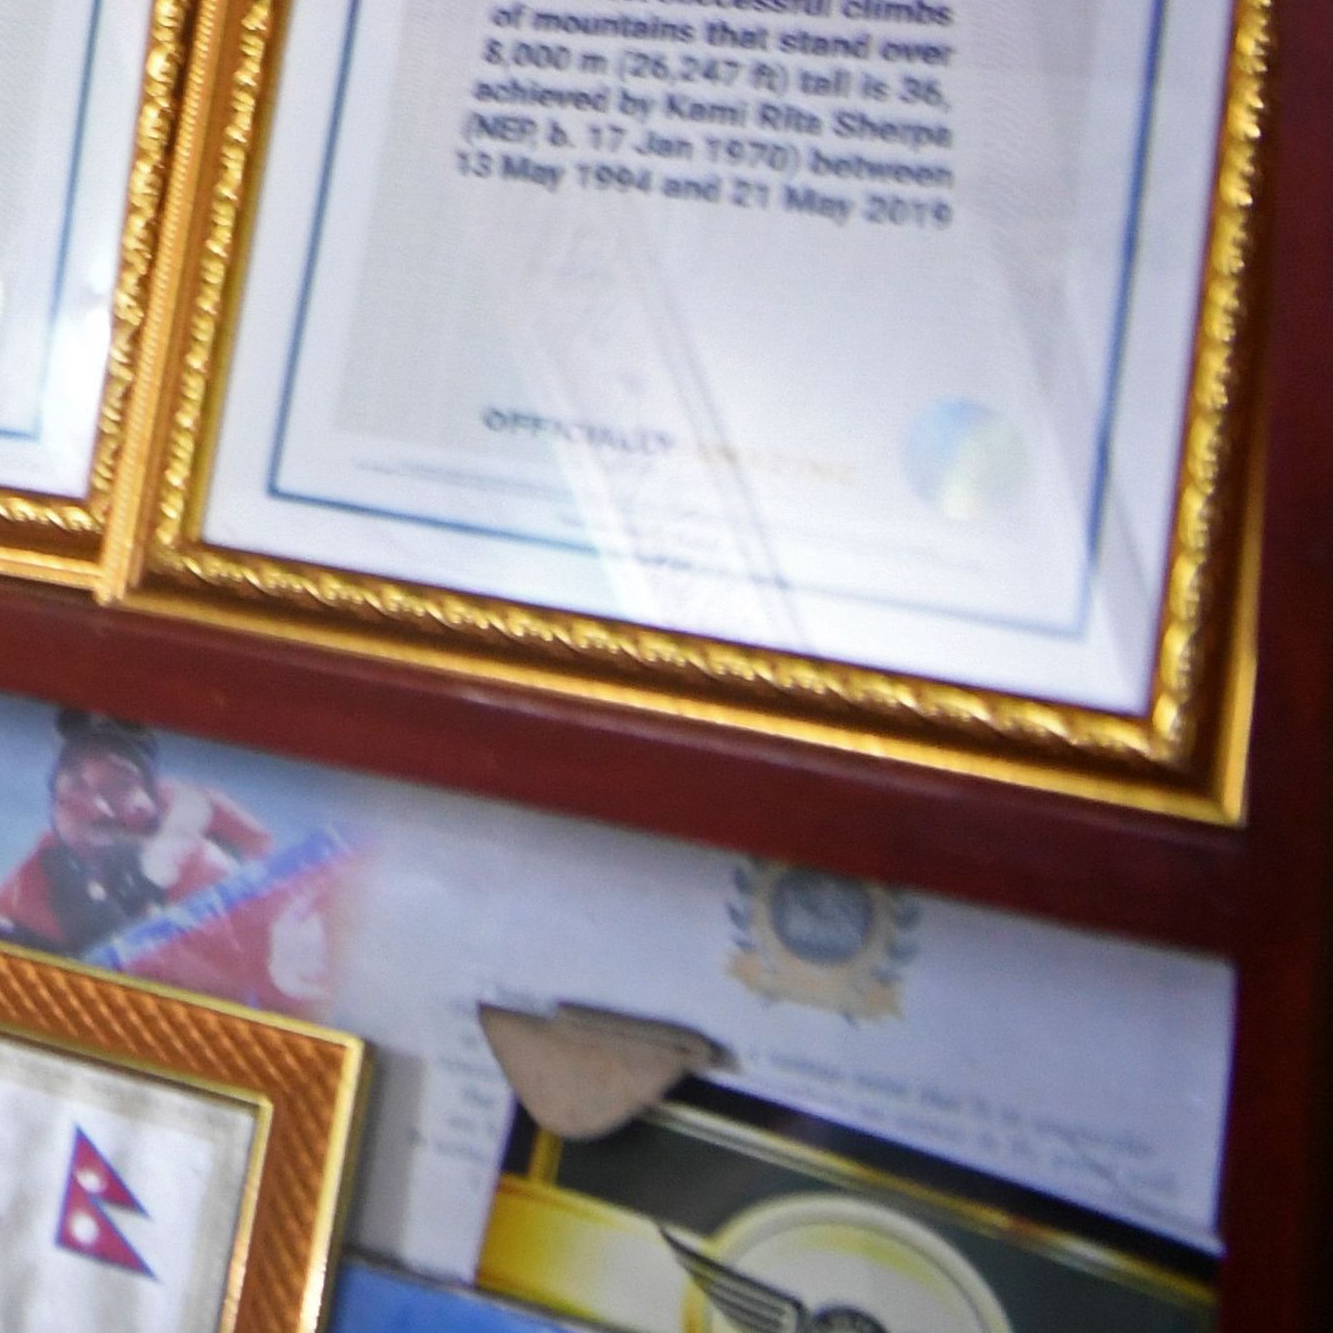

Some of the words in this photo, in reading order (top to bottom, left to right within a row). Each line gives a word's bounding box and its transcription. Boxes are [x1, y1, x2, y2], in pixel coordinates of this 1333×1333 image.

[491, 3, 526, 30] of
[534, 9, 694, 44] mountains
[705, 19, 768, 51] that
[779, 27, 870, 61] stand
[880, 38, 954, 67] over
[473, 77, 608, 112] achieved
[619, 90, 655, 119] by
[665, 94, 746, 128] Kami
[759, 105, 823, 135] Rita
[833, 111, 952, 152] Sherpa
[799, 68, 851, 98] tall
[859, 72, 889, 103] is
[636, 129, 693, 160] Jan
[810, 147, 953, 188] between
[501, 153, 563, 192] May
[661, 172, 721, 203] and
[733, 179, 769, 211] 21
[783, 184, 854, 226] May
[864, 194, 953, 229] 2019
